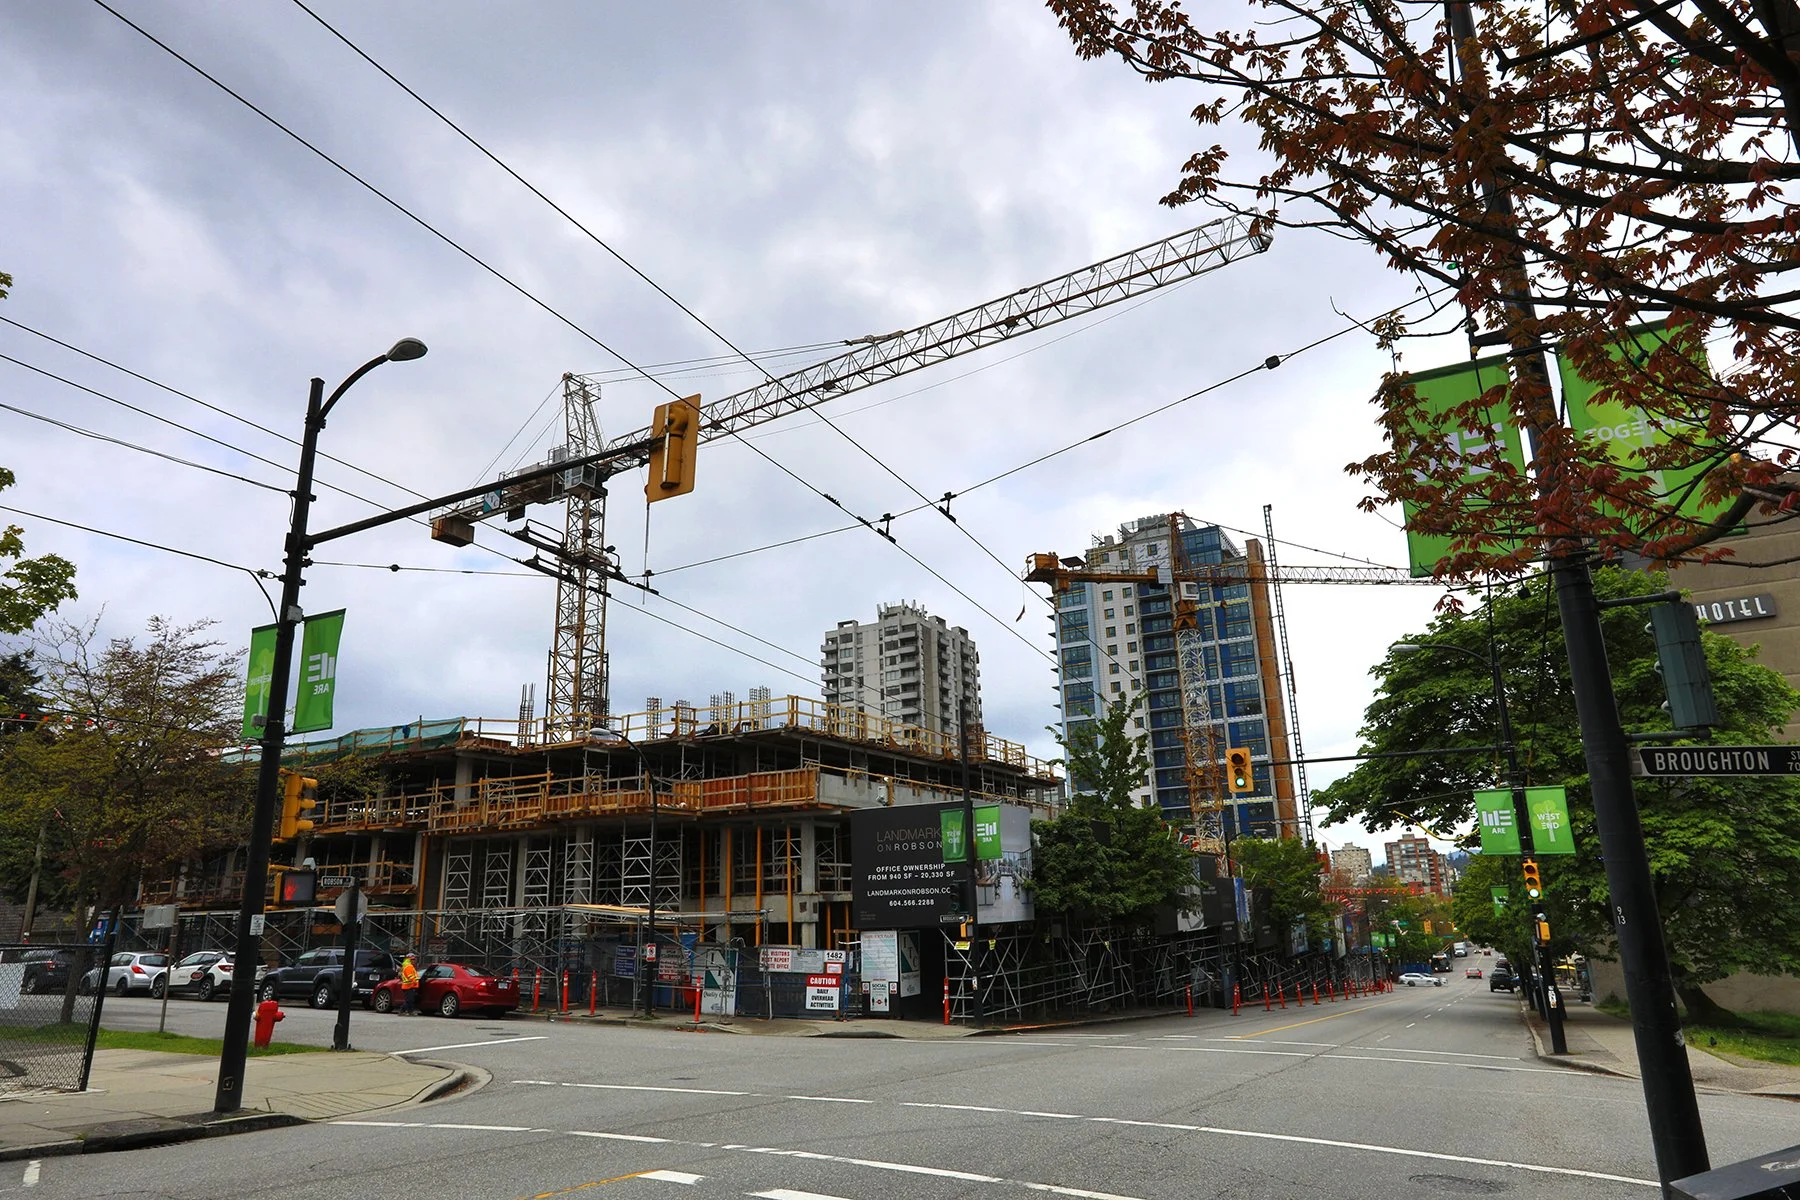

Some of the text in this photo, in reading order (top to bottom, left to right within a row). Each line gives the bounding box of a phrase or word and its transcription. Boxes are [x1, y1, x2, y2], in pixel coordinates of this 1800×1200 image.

[1584, 407, 1705, 442] TOGETH
[1696, 597, 1767, 620] HOTEL
[1655, 751, 1770, 771] BROUGHTON
[1537, 812, 1561, 820] WEST
[1541, 822, 1560, 830] END
[876, 826, 942, 842] LANDMARK
[876, 863, 946, 873] OFFICE OWNERSHIP
[867, 887, 951, 897] LANDMARKONROBSON.CO
[889, 899, 935, 907] 604.566.2288
[1616, 905, 1623, 915] 9
[1617, 915, 1627, 925] 13
[809, 976, 837, 985] CAUTION
